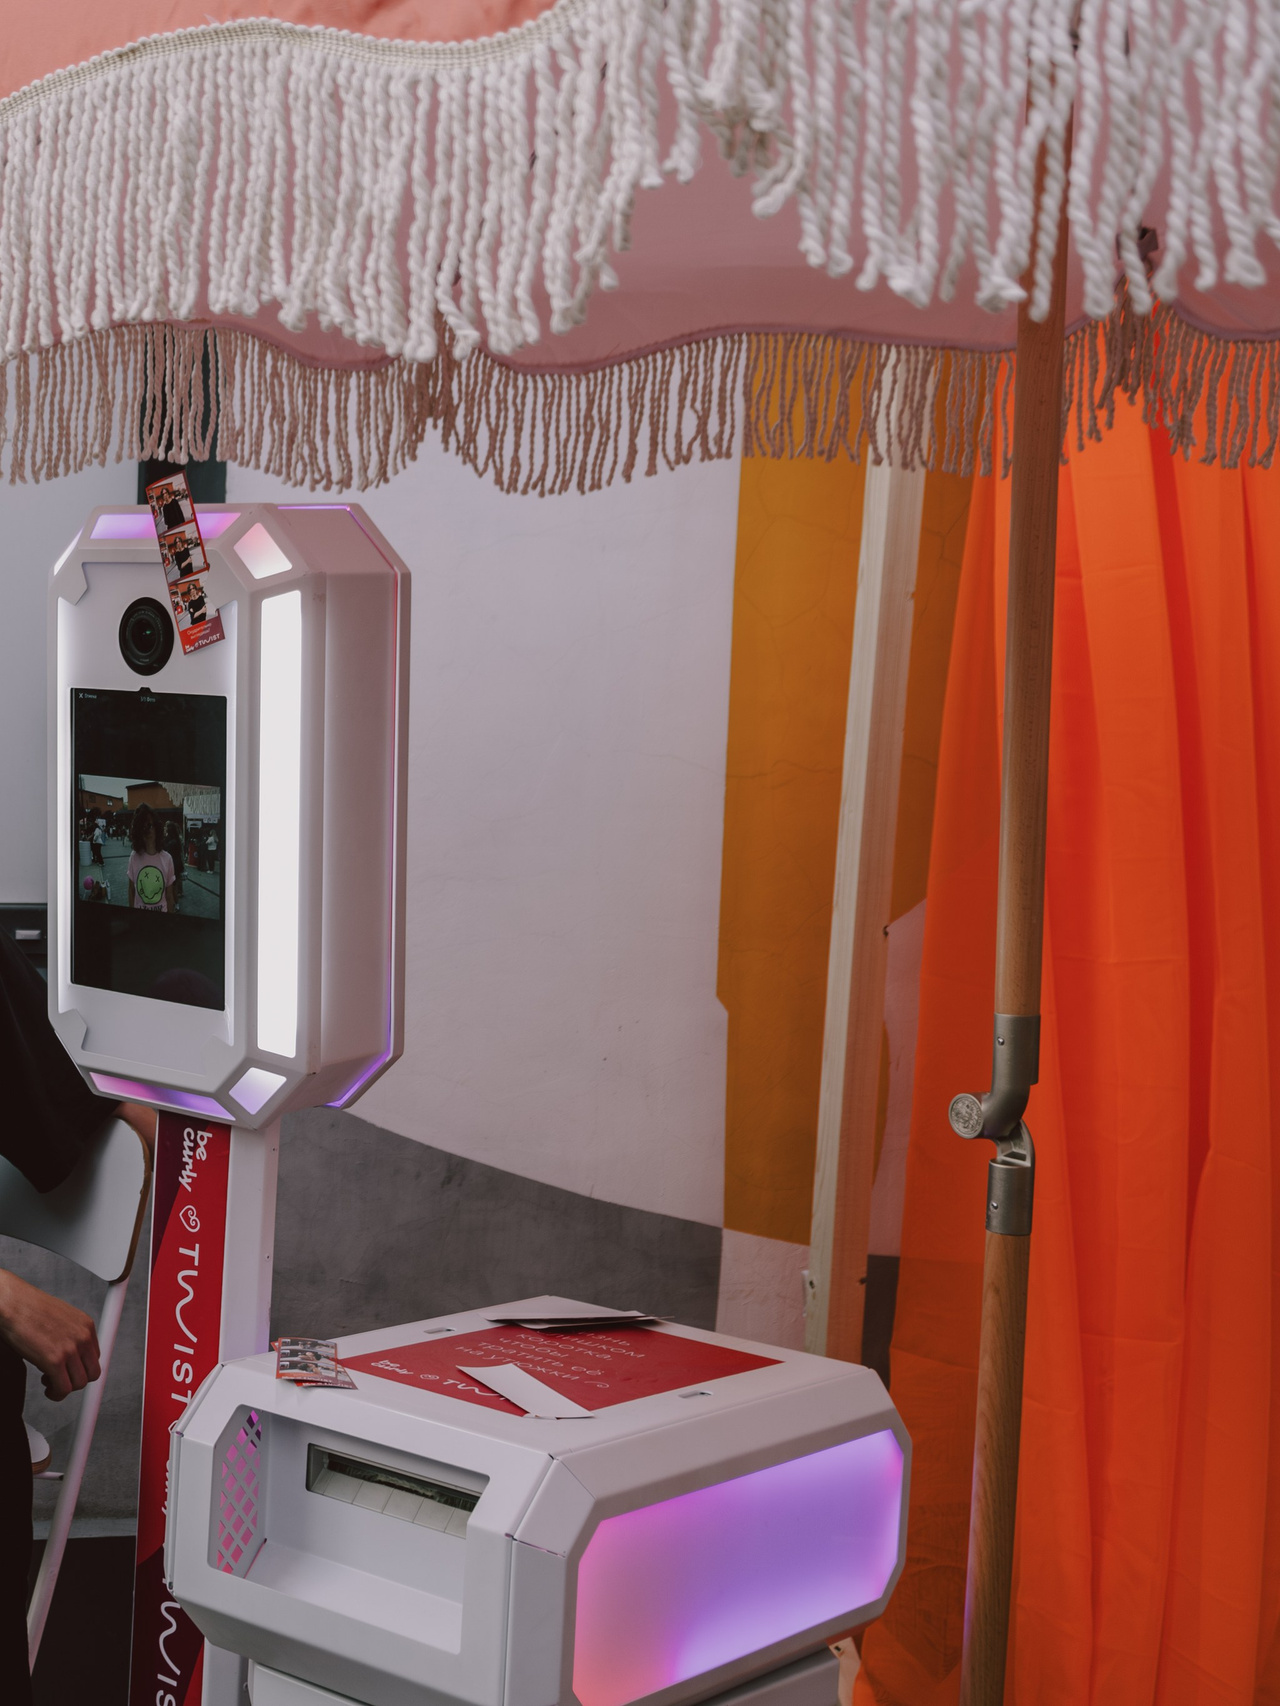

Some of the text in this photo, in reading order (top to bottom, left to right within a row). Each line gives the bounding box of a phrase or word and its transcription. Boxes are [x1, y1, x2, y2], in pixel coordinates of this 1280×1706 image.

[178, 1127, 198, 1192] curly
[195, 1130, 213, 1161] be
[171, 1243, 200, 1405] TWIST
[155, 1578, 182, 1706] WIS
